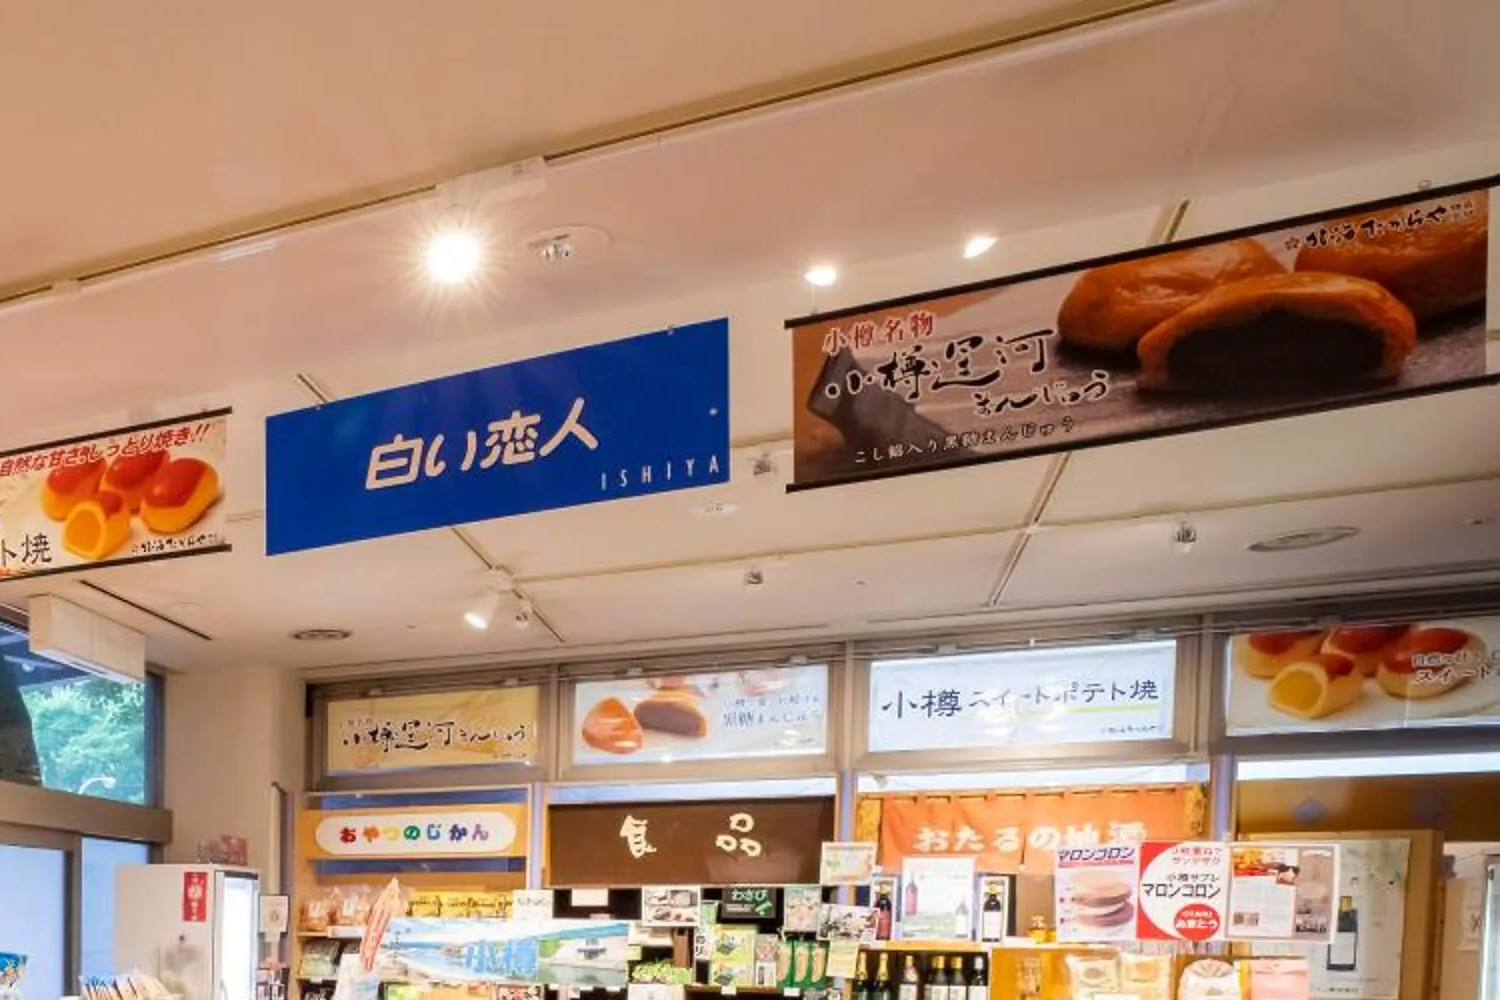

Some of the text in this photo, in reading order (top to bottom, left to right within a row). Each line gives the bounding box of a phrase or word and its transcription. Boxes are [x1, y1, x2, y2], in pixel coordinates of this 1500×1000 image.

[822, 312, 933, 355] 小樽名物
[974, 370, 1109, 416] まんじゅう
[365, 397, 598, 490] 白い恋人
[601, 454, 720, 490] ISHIYA
[339, 823, 489, 844] おやつのじかん
[619, 813, 762, 859] 食品
[1142, 883, 1221, 898] マロンコロン
